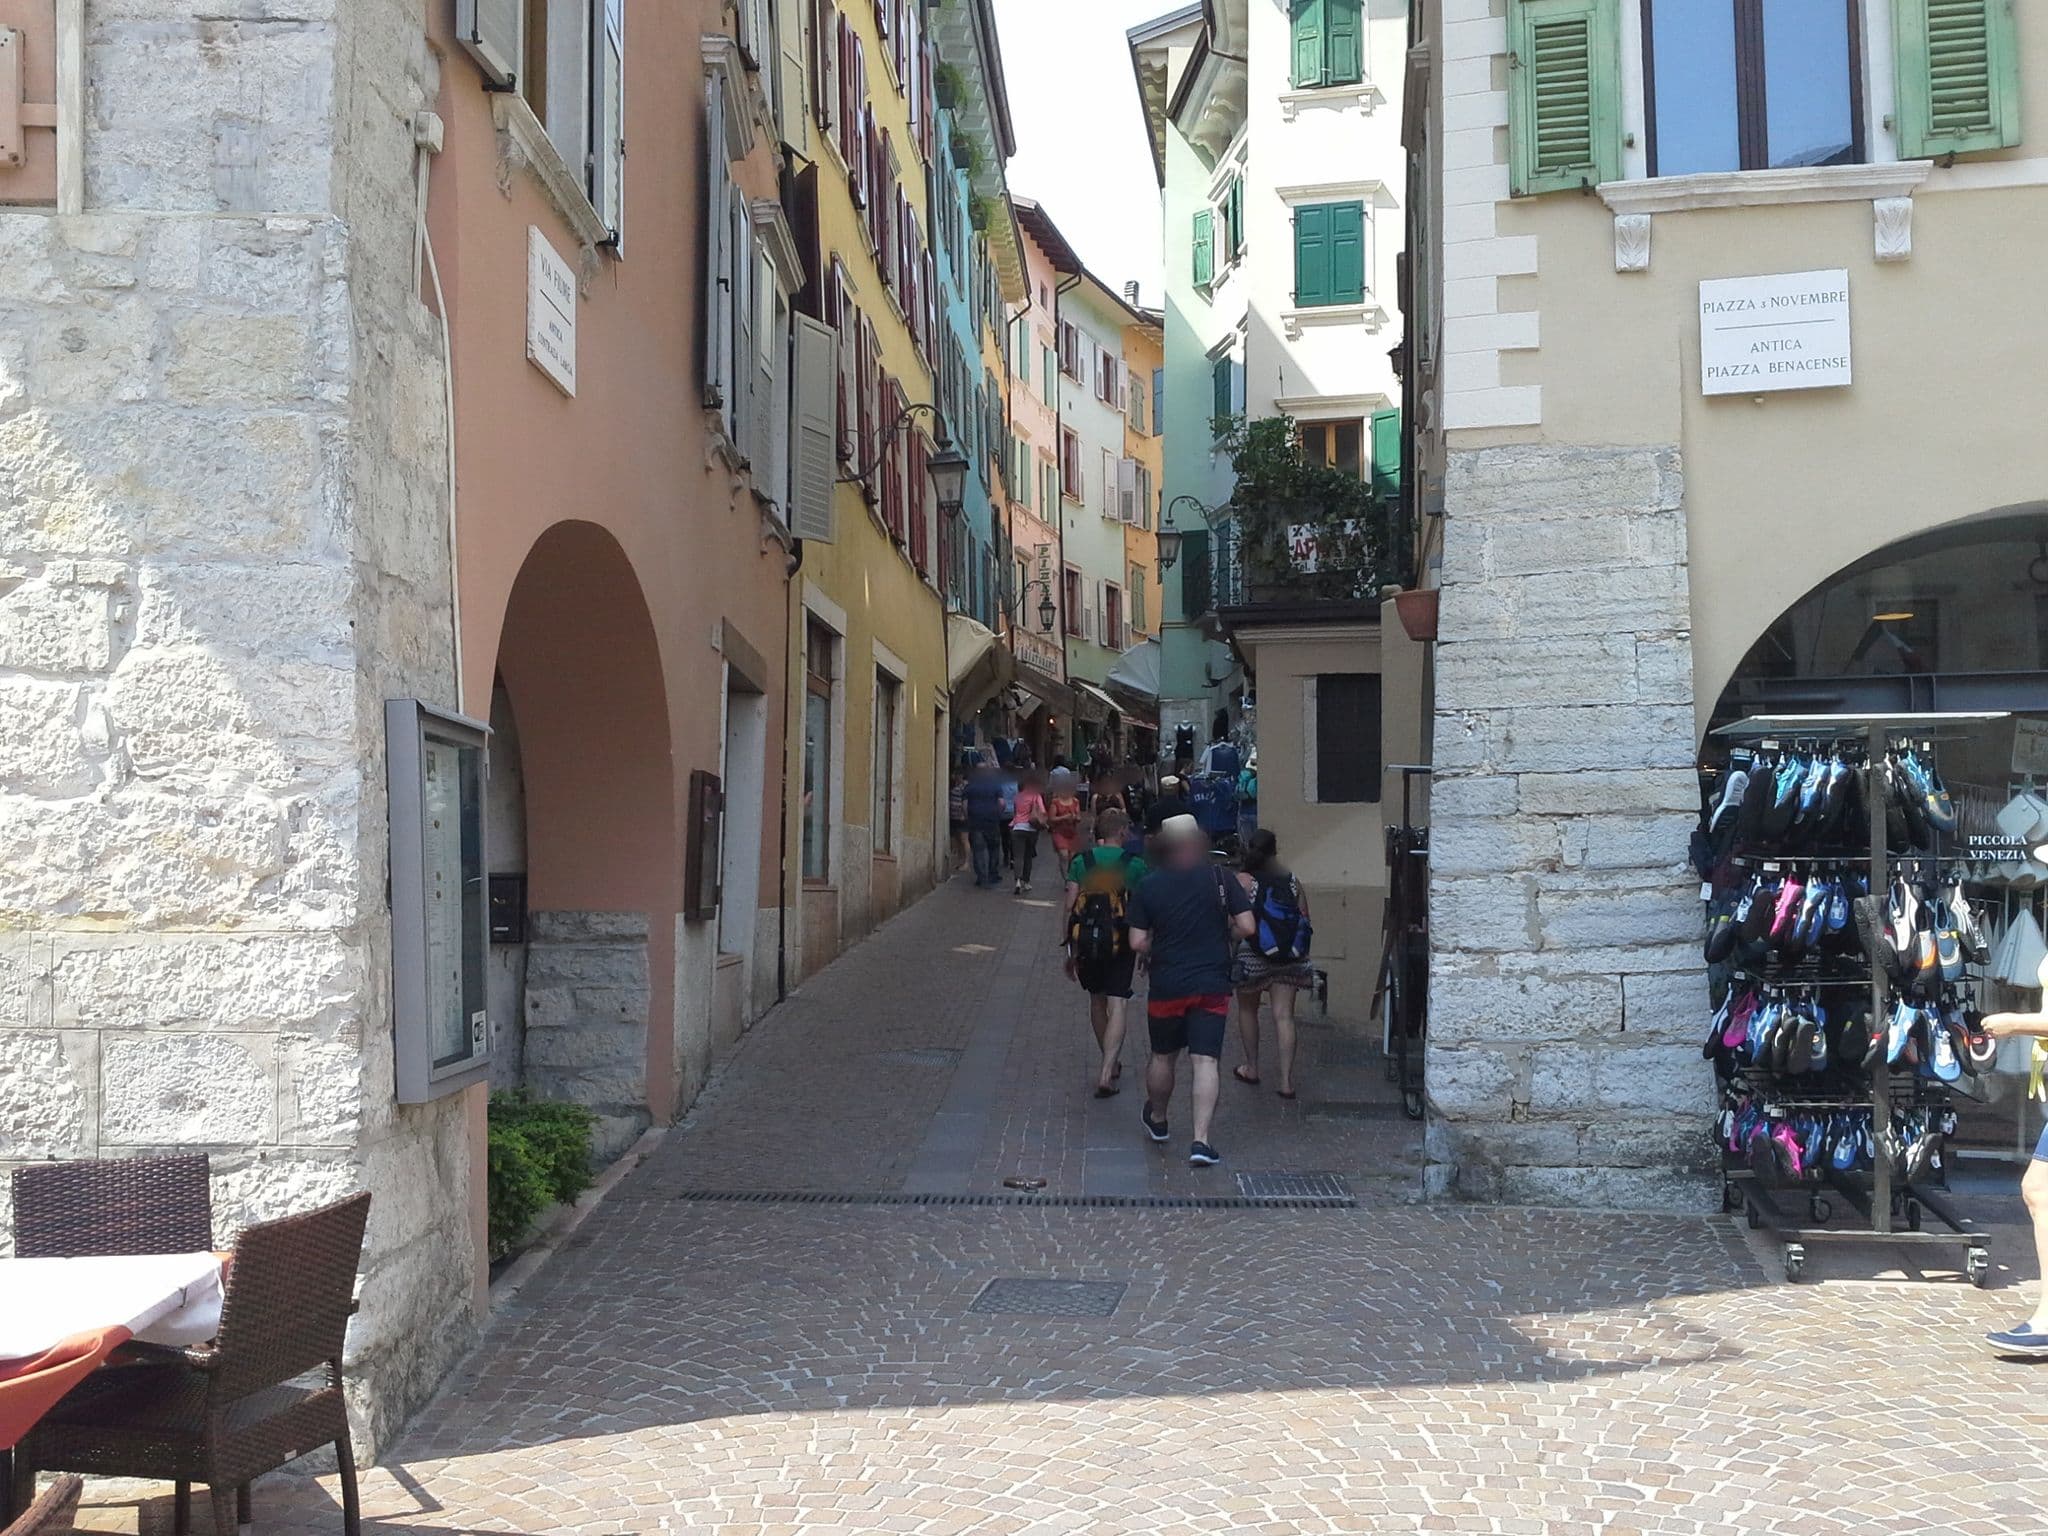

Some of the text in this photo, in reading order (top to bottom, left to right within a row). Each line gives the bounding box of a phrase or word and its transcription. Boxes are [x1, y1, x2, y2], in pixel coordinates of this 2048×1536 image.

[540, 253, 572, 305] VIA FIUME
[1703, 290, 1847, 314] PIAZZA 3 NOVEMBRE
[548, 319, 563, 344] ANTICA
[536, 331, 559, 362] CONTRADA
[1749, 338, 1803, 354] ANTICA
[1707, 356, 1849, 379] PIAZZA BENACENSE
[1969, 834, 2028, 847] PICCOLA
[1970, 849, 2027, 861] VENEZIA
